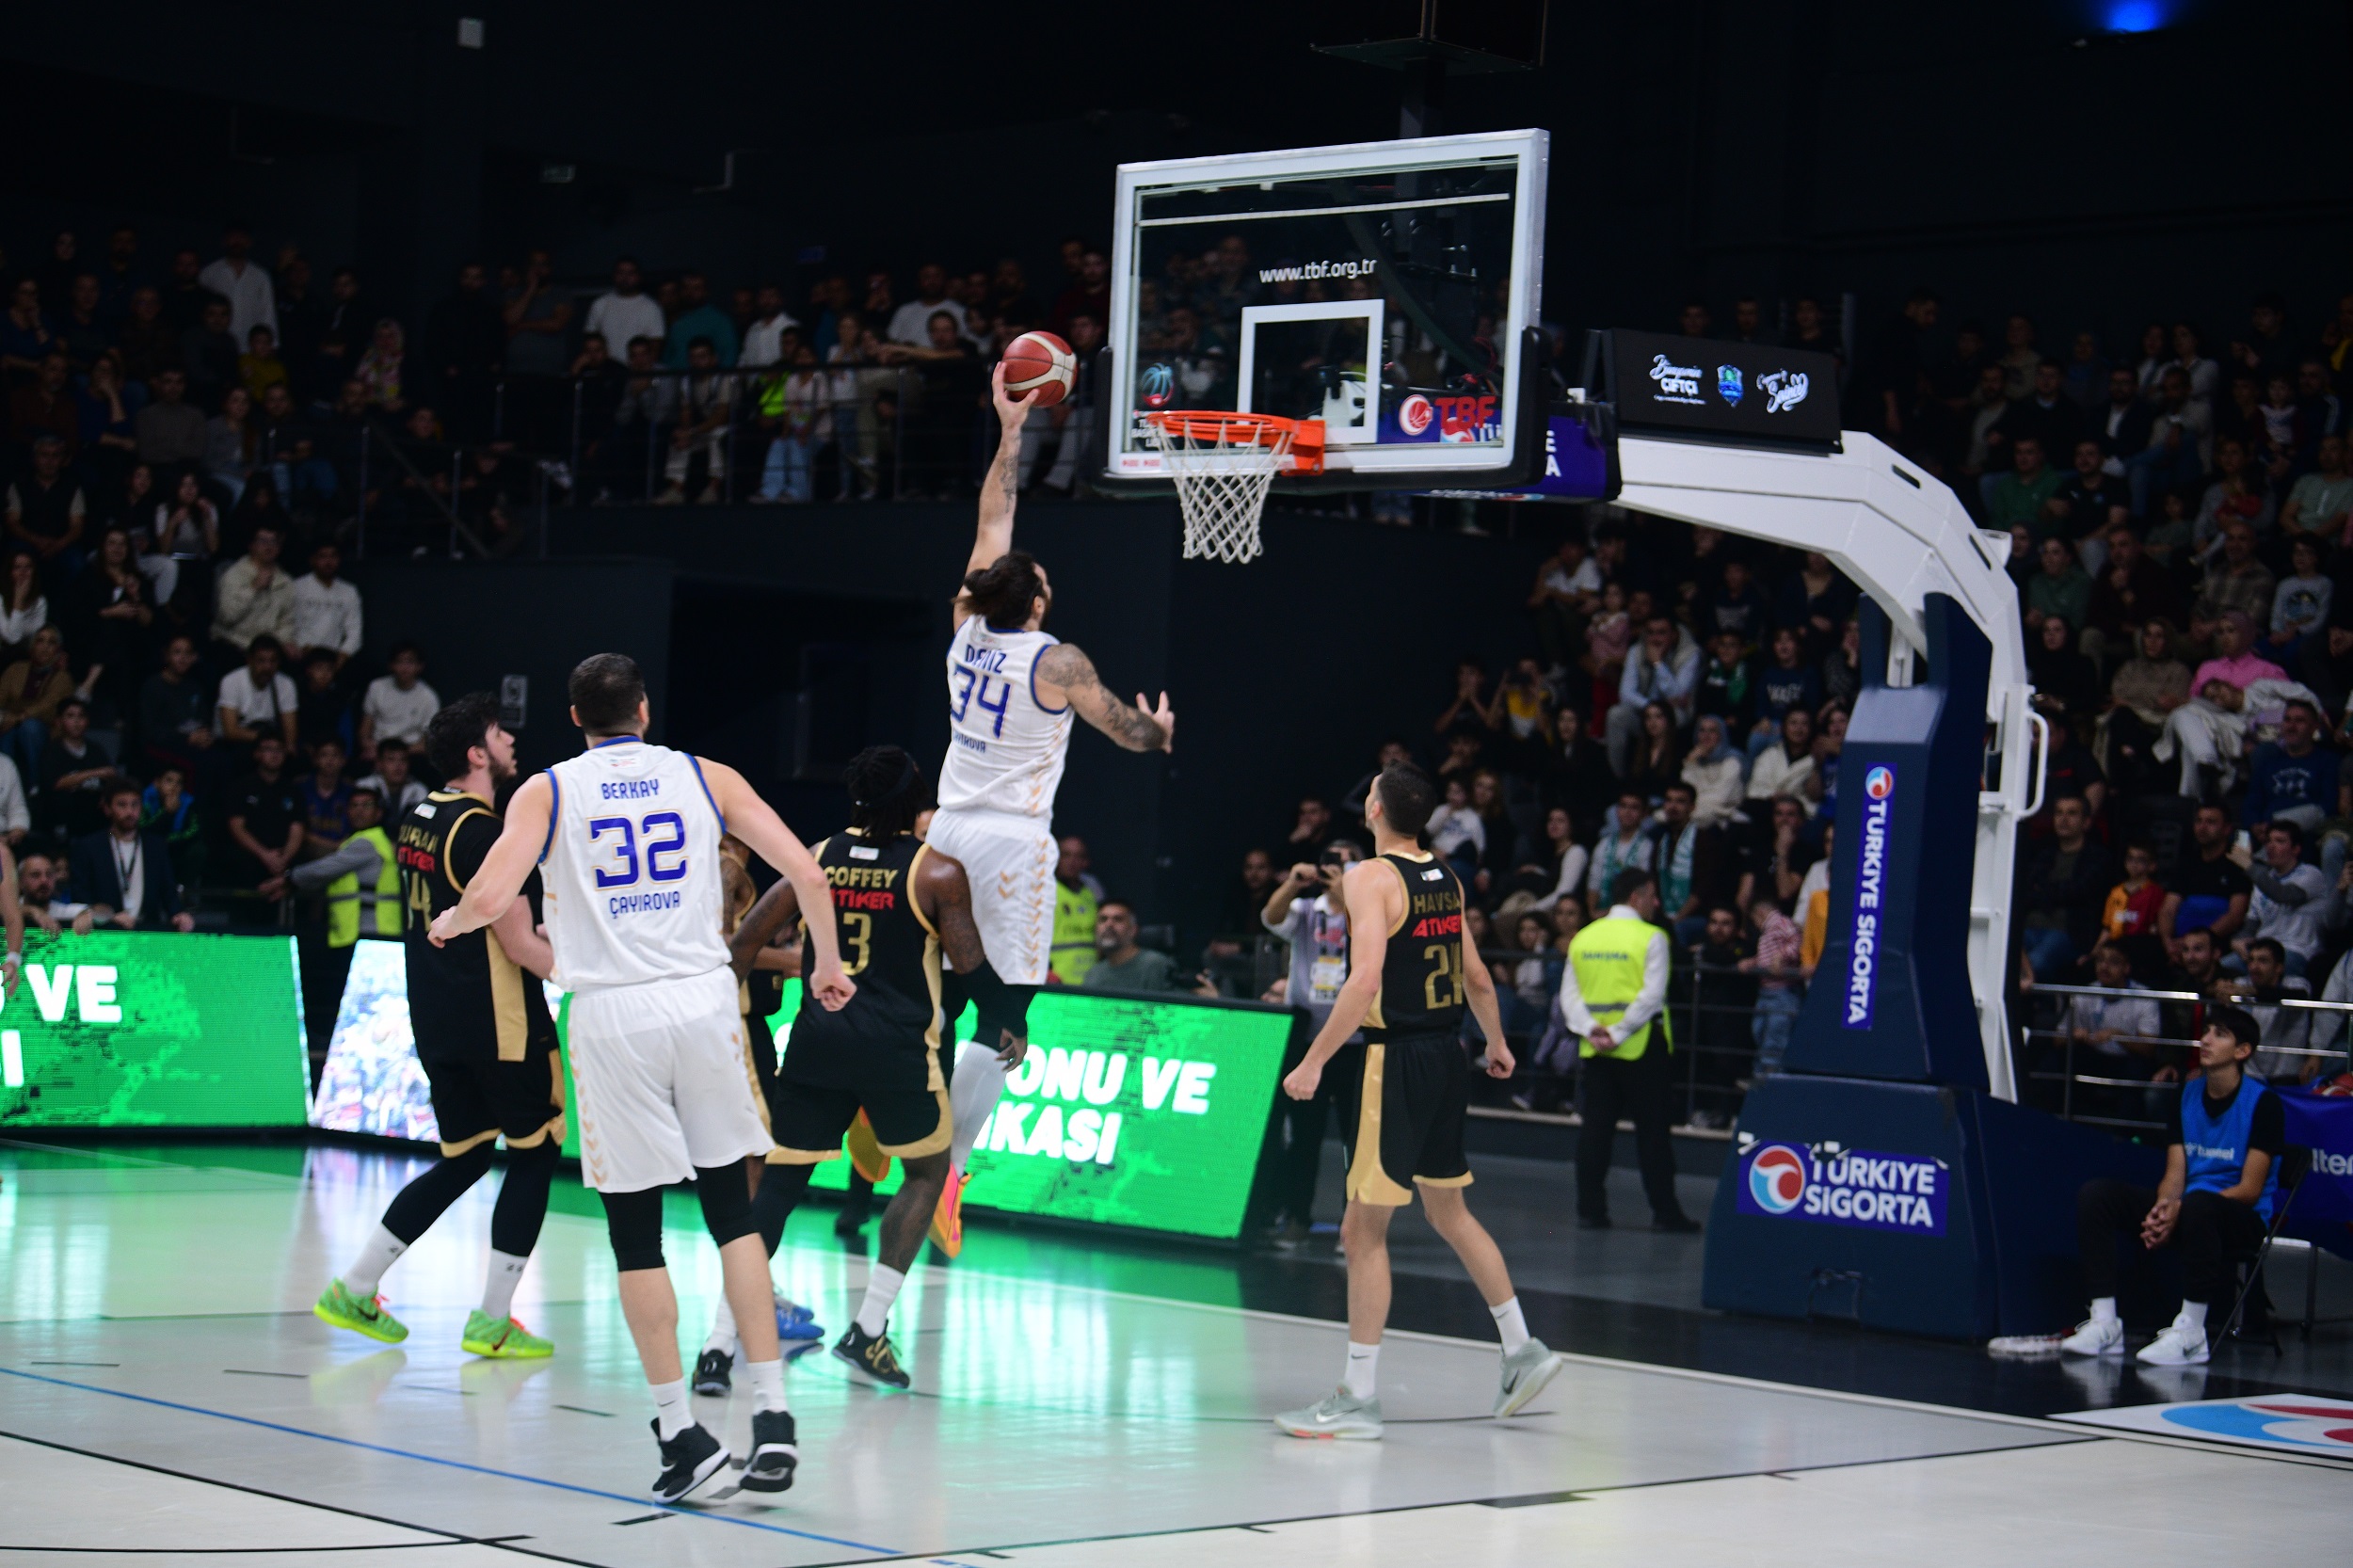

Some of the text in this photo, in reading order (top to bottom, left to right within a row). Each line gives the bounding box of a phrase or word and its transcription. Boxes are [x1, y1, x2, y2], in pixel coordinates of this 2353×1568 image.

[1259, 259, 1377, 283] www.tbf.org.tr
[1435, 395, 1498, 431] TBF
[950, 664, 1011, 739] 34
[601, 778, 660, 800] BERKAY
[588, 810, 688, 889] 32
[824, 866, 898, 888] COFFEY
[610, 891, 680, 919] ÇAYIROVA
[842, 913, 872, 976] 3
[24, 964, 122, 1023] VE
[1006, 1045, 1216, 1115] ONU VE
